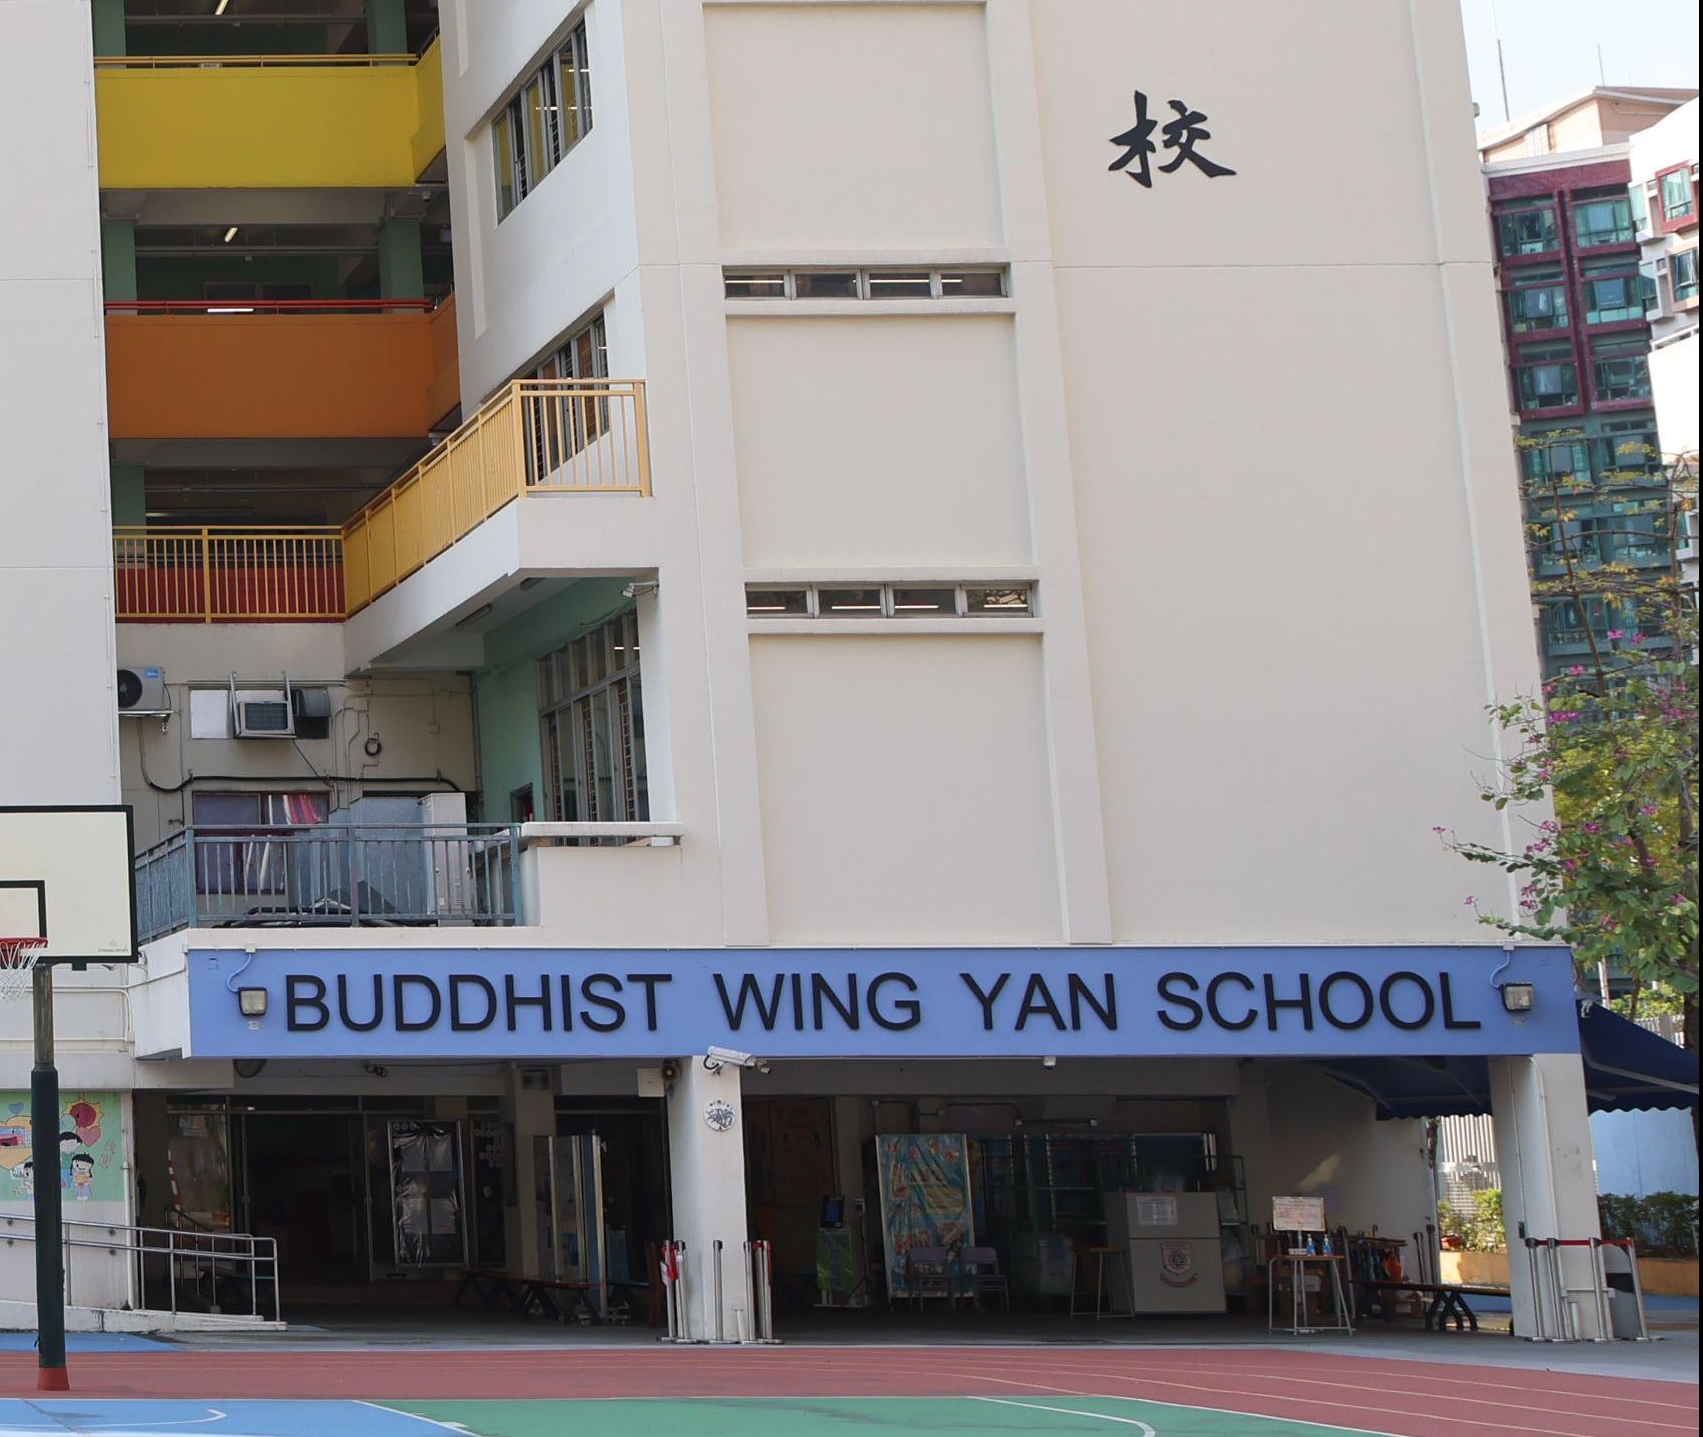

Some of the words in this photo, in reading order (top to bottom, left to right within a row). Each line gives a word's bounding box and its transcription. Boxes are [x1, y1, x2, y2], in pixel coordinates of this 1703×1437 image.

[286, 974, 672, 1032] BUDDHIST
[713, 973, 922, 1031] WING
[959, 972, 1118, 1031] YAN
[1157, 971, 1481, 1031] SCHOOL
